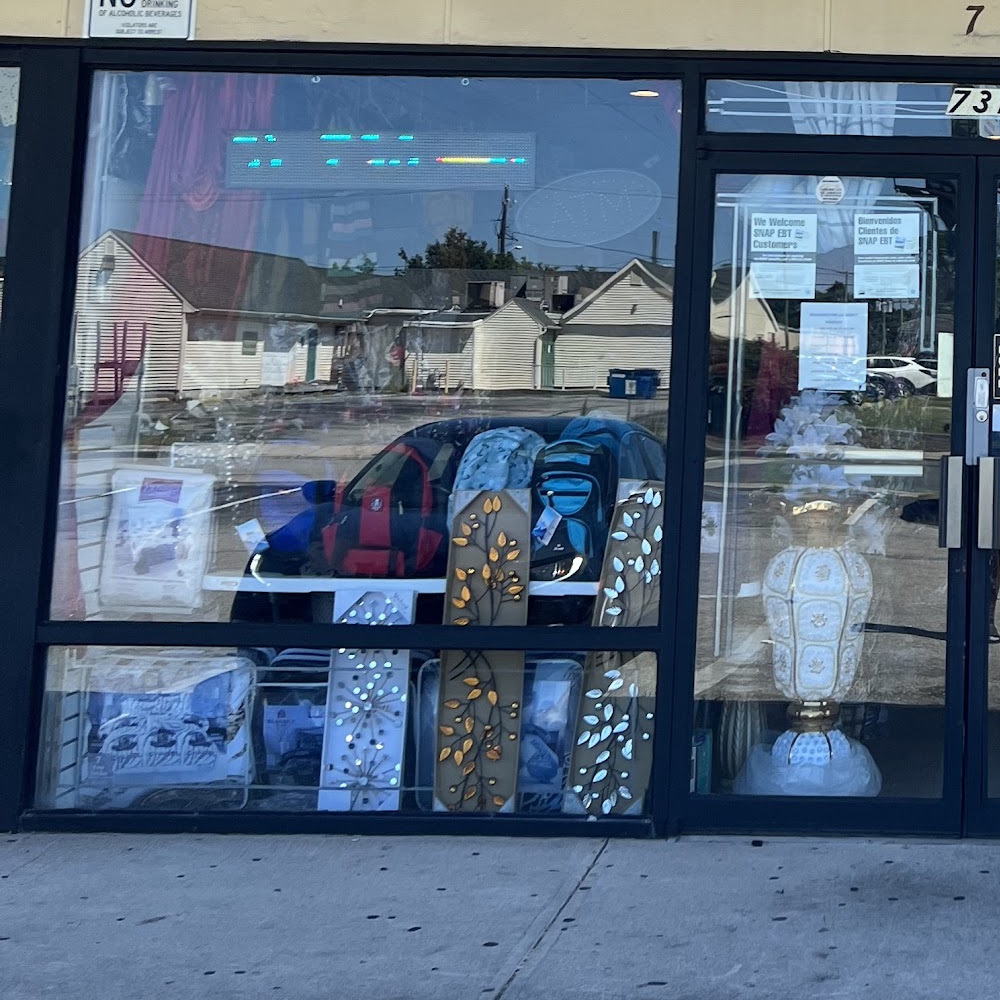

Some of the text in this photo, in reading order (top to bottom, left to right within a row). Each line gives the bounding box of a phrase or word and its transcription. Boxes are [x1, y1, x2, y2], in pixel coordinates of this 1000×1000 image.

[141, 0, 179, 9] DRINKING
[145, 10, 183, 18] BEVERAGES
[965, 5, 986, 35] 7
[753, 217, 806, 227] We Welcome
[858, 216, 902, 225] Bienvenidos
[753, 228, 792, 238] SNAP EBT
[858, 226, 899, 235] Clientes de
[753, 239, 798, 249] Customers
[858, 236, 893, 245] SNAP EBT
